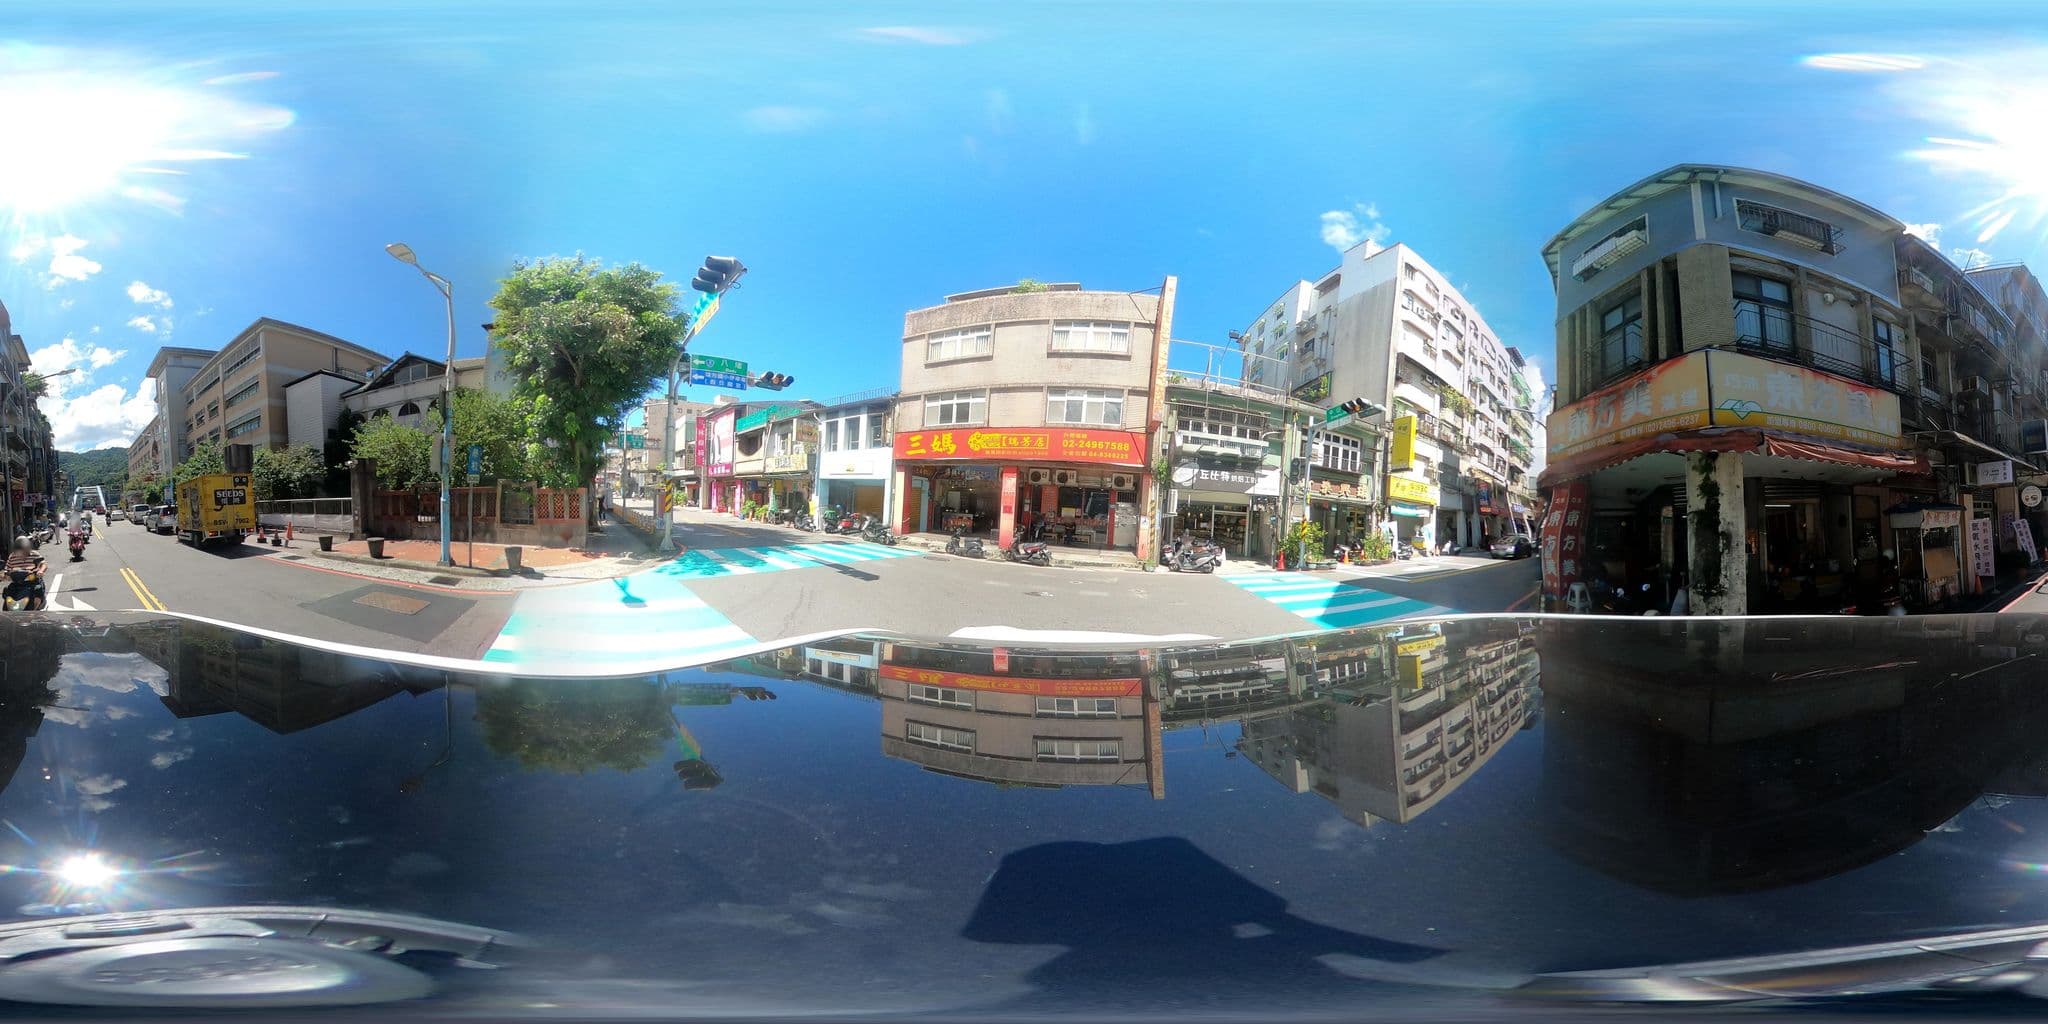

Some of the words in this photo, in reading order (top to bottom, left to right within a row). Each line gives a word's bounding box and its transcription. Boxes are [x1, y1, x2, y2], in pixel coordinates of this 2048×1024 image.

[905, 432, 957, 456] 三媽
[1062, 439, 1130, 451] 02-24967588
[216, 489, 245, 498] SEEDS
